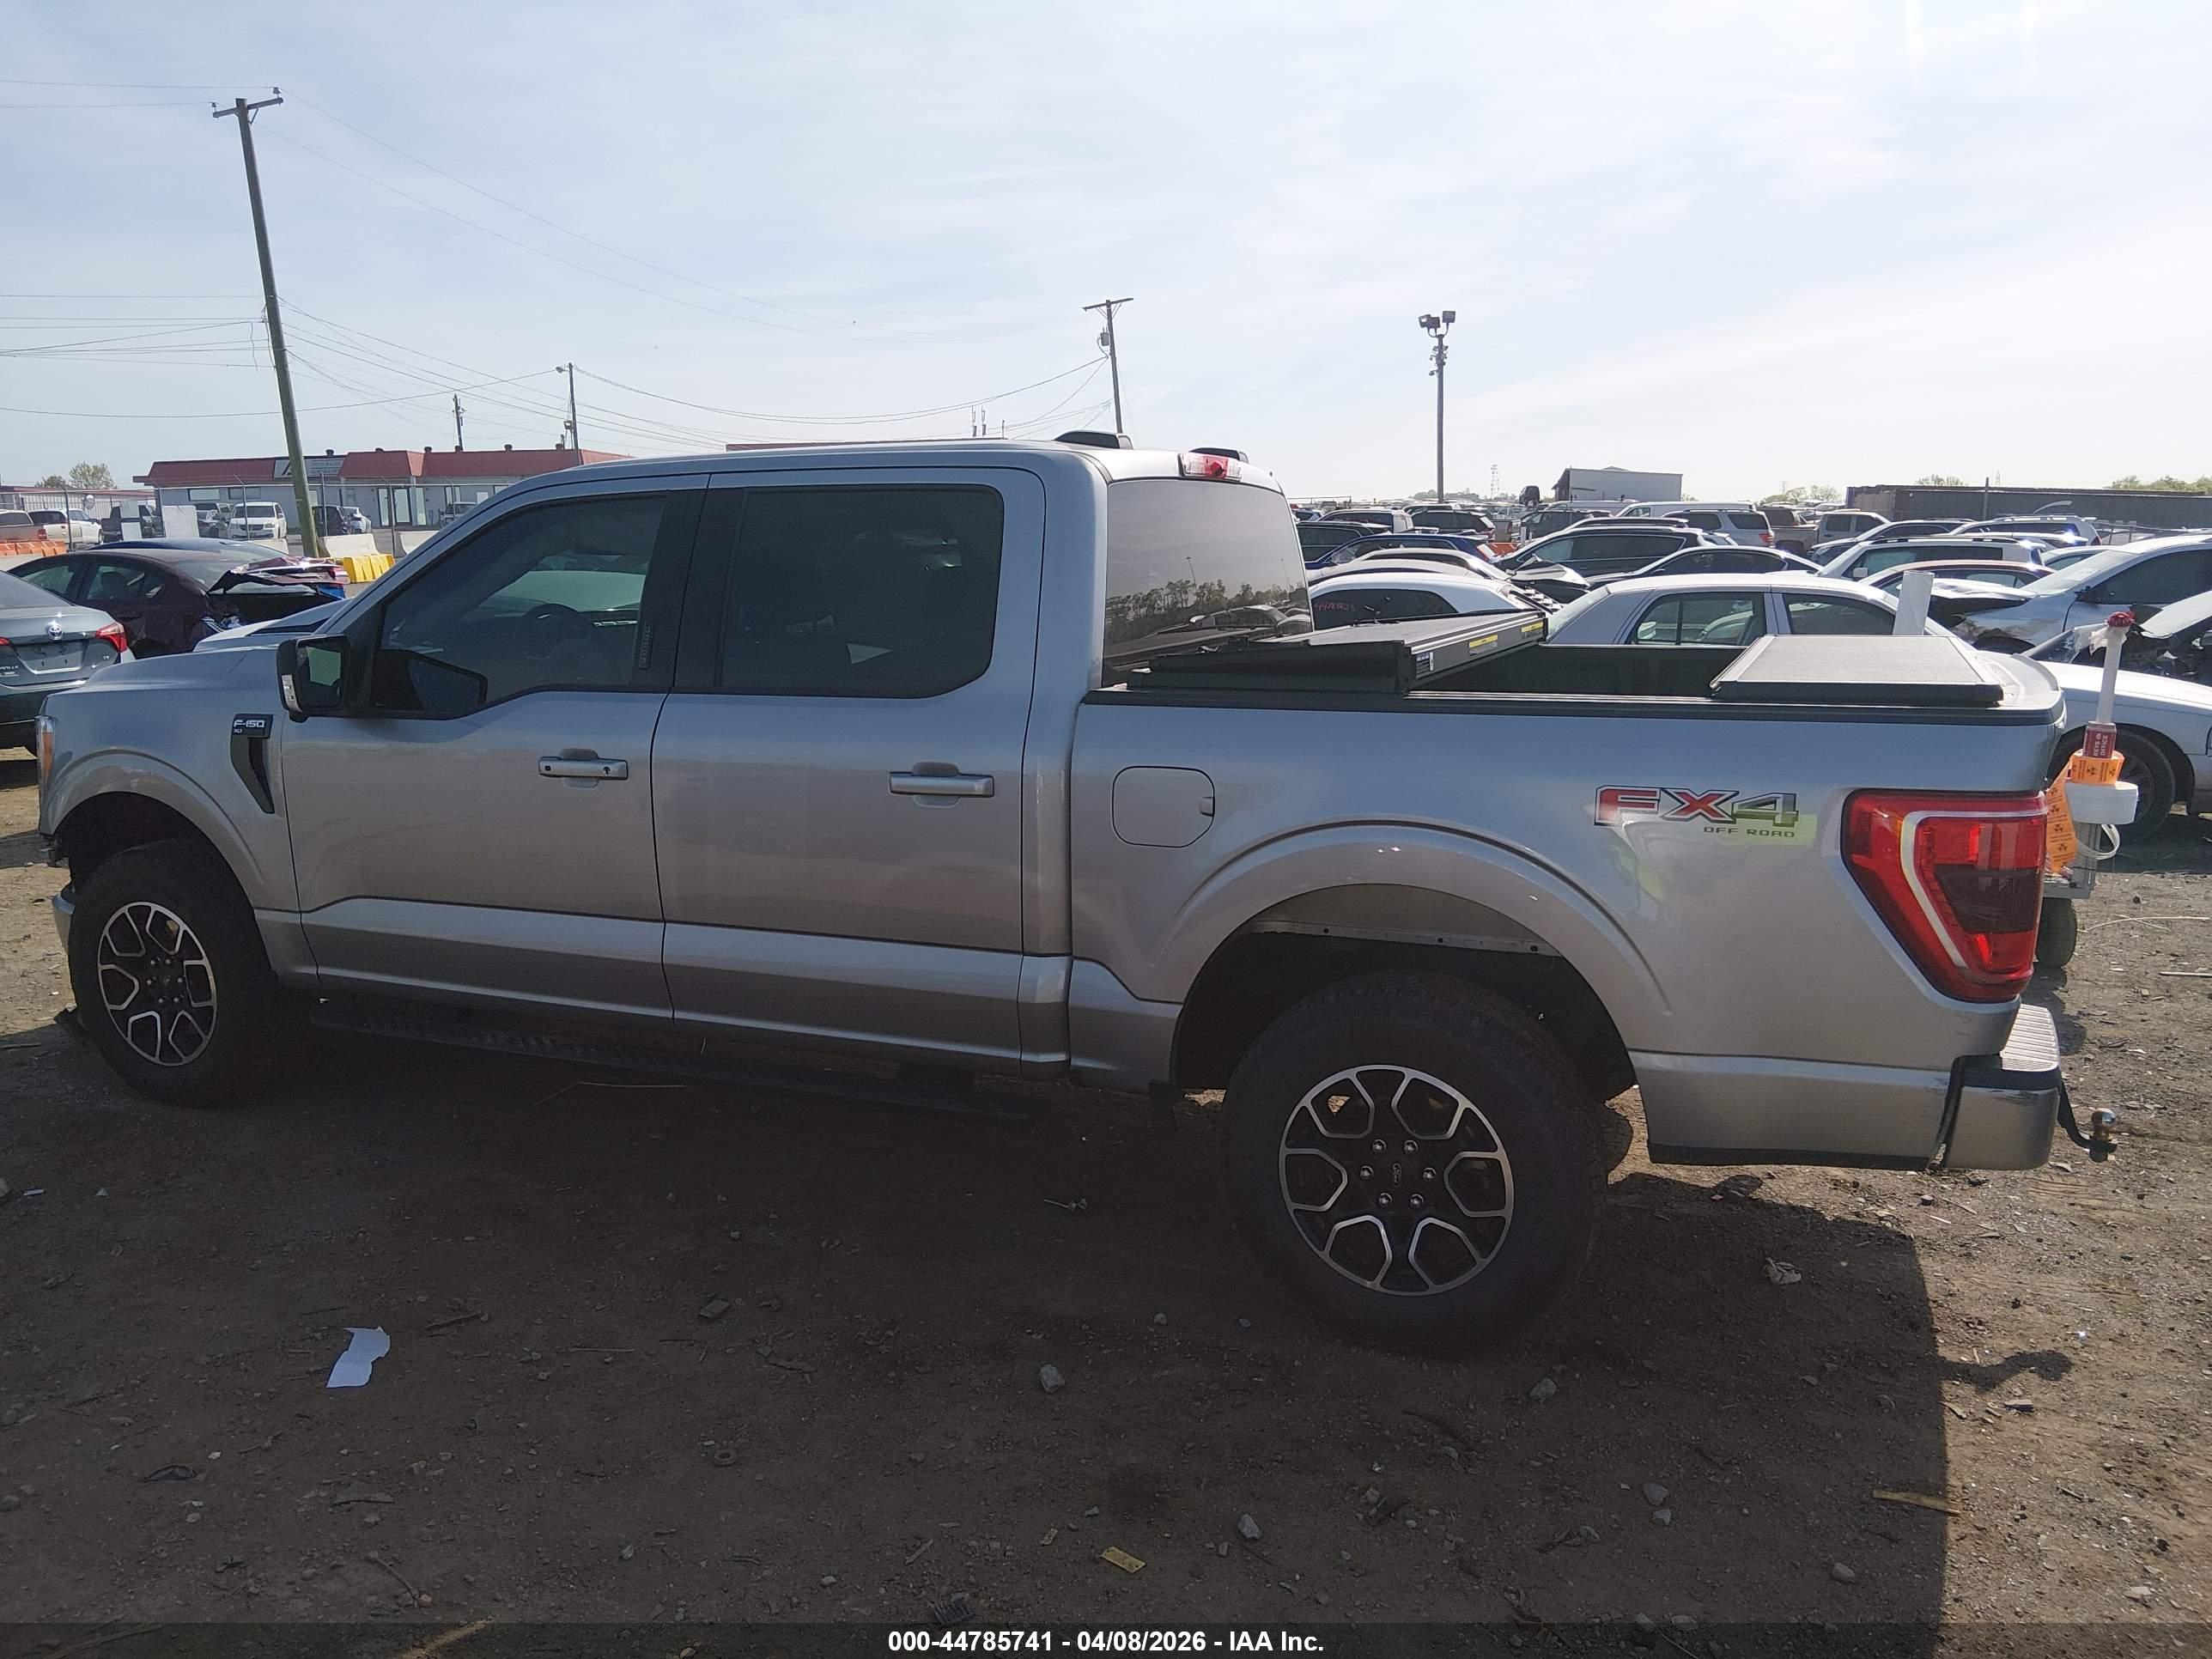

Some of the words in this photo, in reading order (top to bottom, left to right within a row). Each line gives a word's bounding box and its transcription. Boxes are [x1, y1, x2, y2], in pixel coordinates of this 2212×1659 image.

[234, 719, 265, 728] F-150
[2100, 734, 2109, 756] OFFICE
[1594, 785, 1799, 827] FX4
[1703, 826, 1739, 835] OFF
[1746, 828, 1796, 838] ROAD
